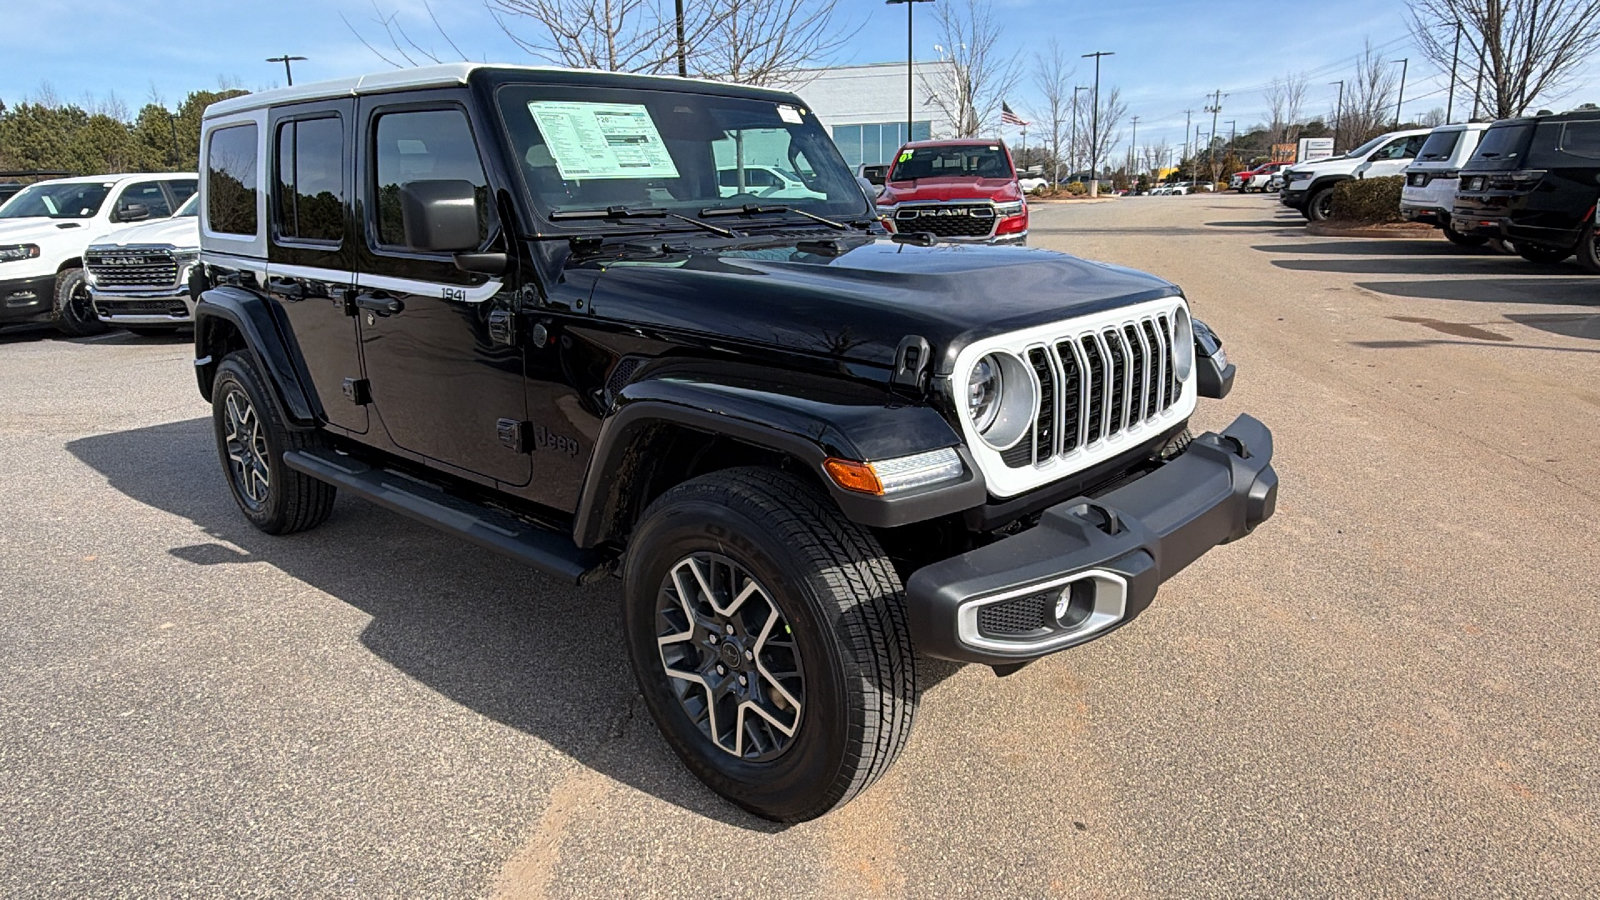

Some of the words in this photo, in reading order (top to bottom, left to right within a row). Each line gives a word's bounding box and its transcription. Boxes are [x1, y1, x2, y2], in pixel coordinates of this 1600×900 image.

[920, 208, 968, 217] RAM
[101, 257, 145, 265] RAM
[441, 287, 466, 302] 1941
[537, 426, 579, 458] Jeep
